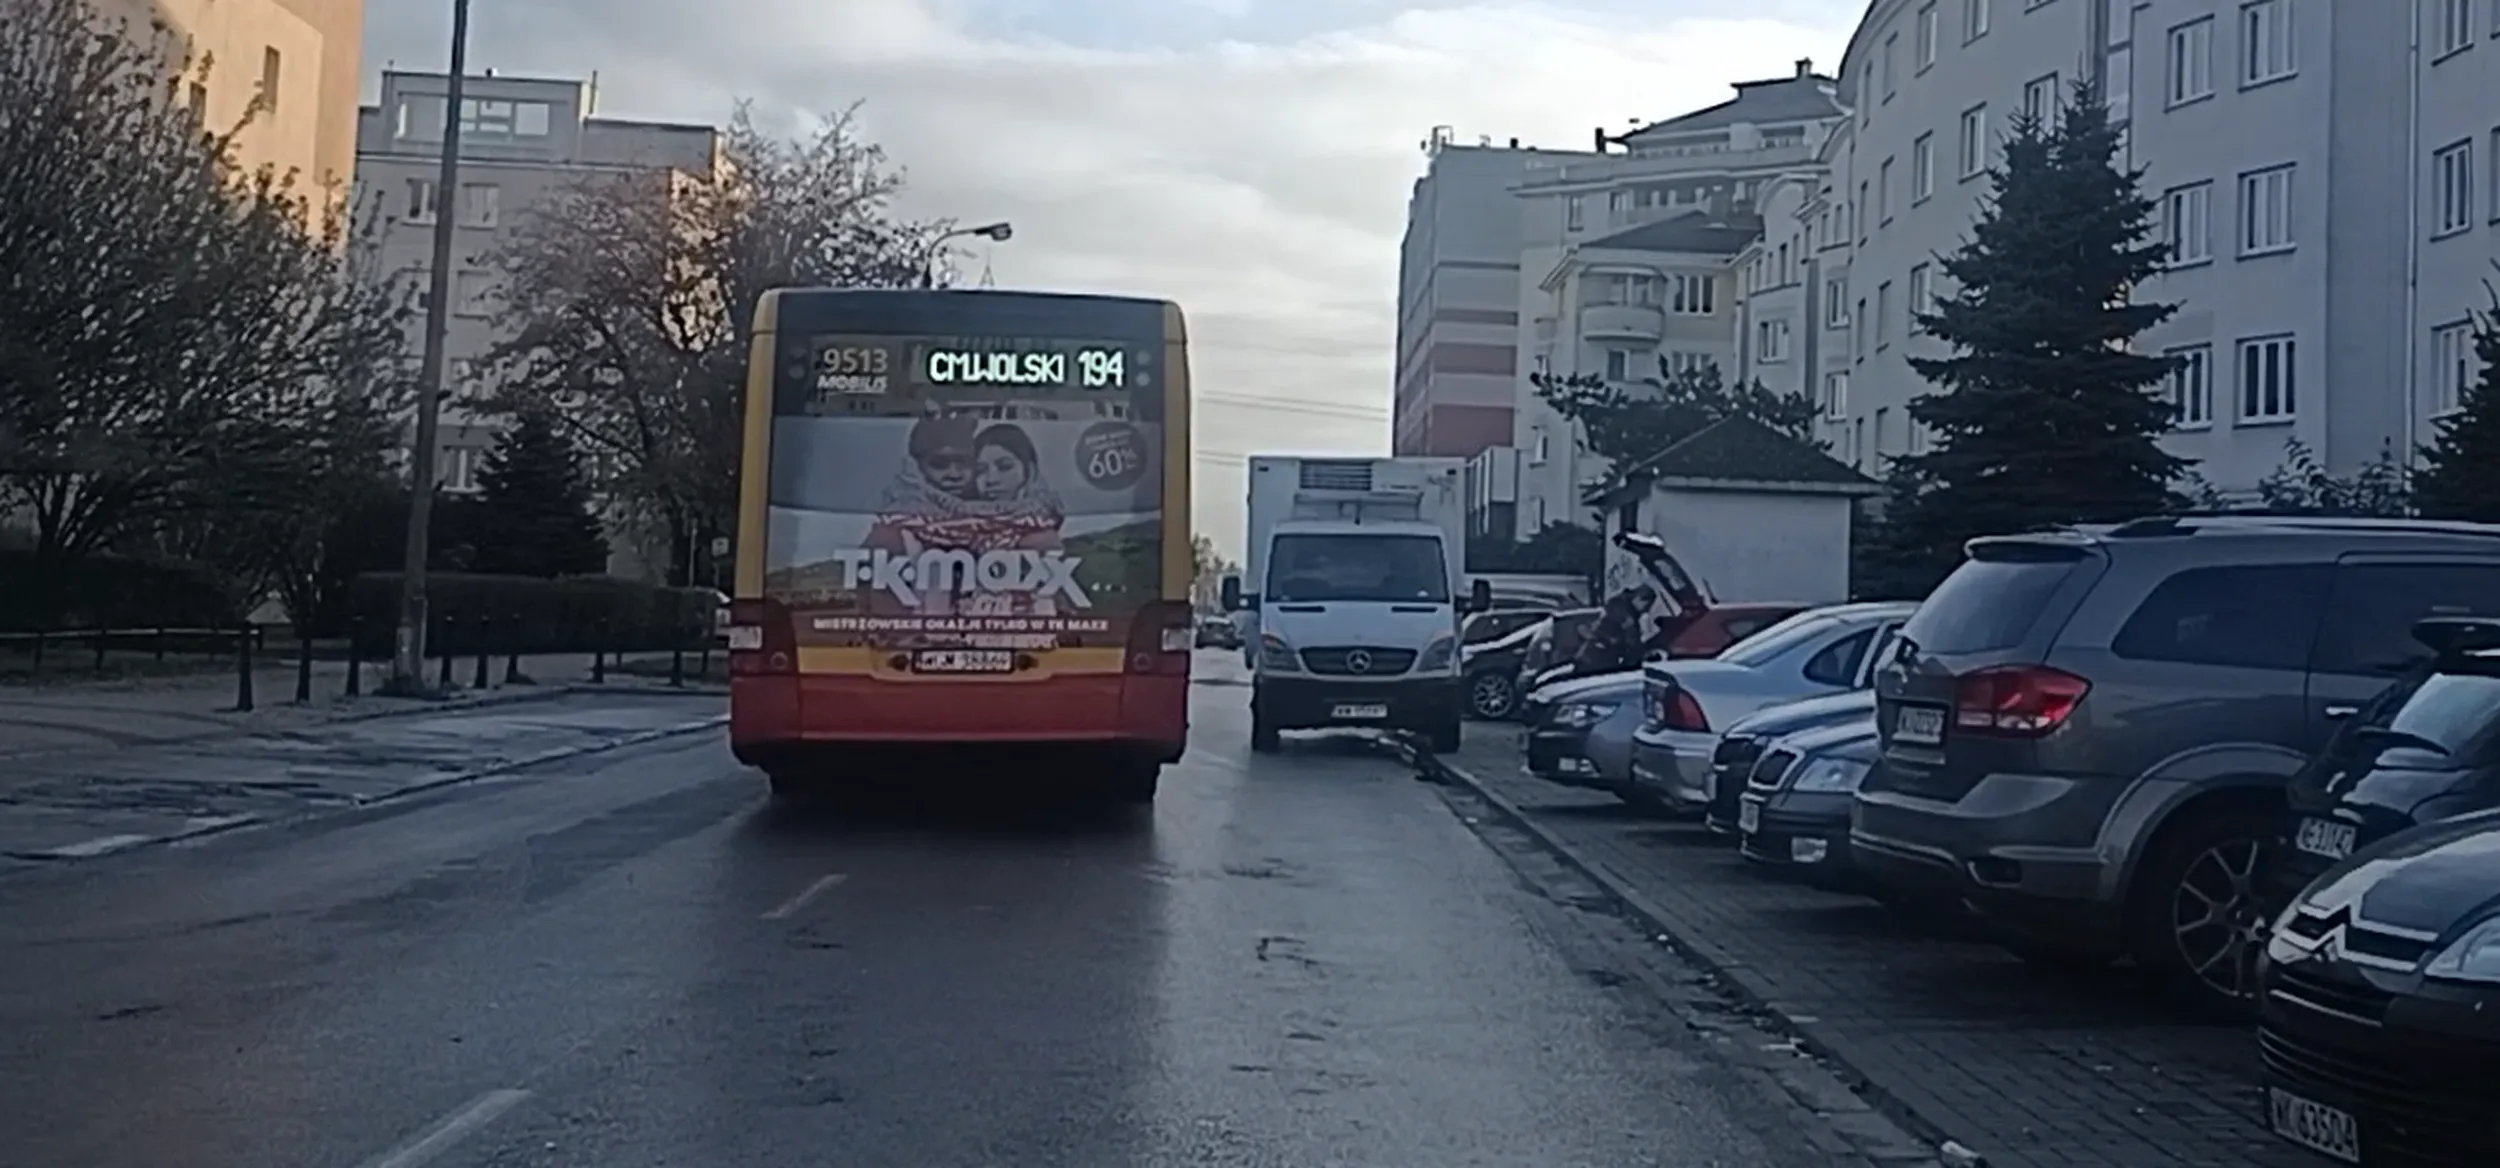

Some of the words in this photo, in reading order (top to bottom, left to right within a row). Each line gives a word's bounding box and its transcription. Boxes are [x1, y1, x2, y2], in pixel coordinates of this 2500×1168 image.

[823, 348, 888, 373] 9513
[1077, 350, 1124, 387] 194
[817, 375, 888, 391] MOBILIS
[1030, 619, 1045, 631] W
